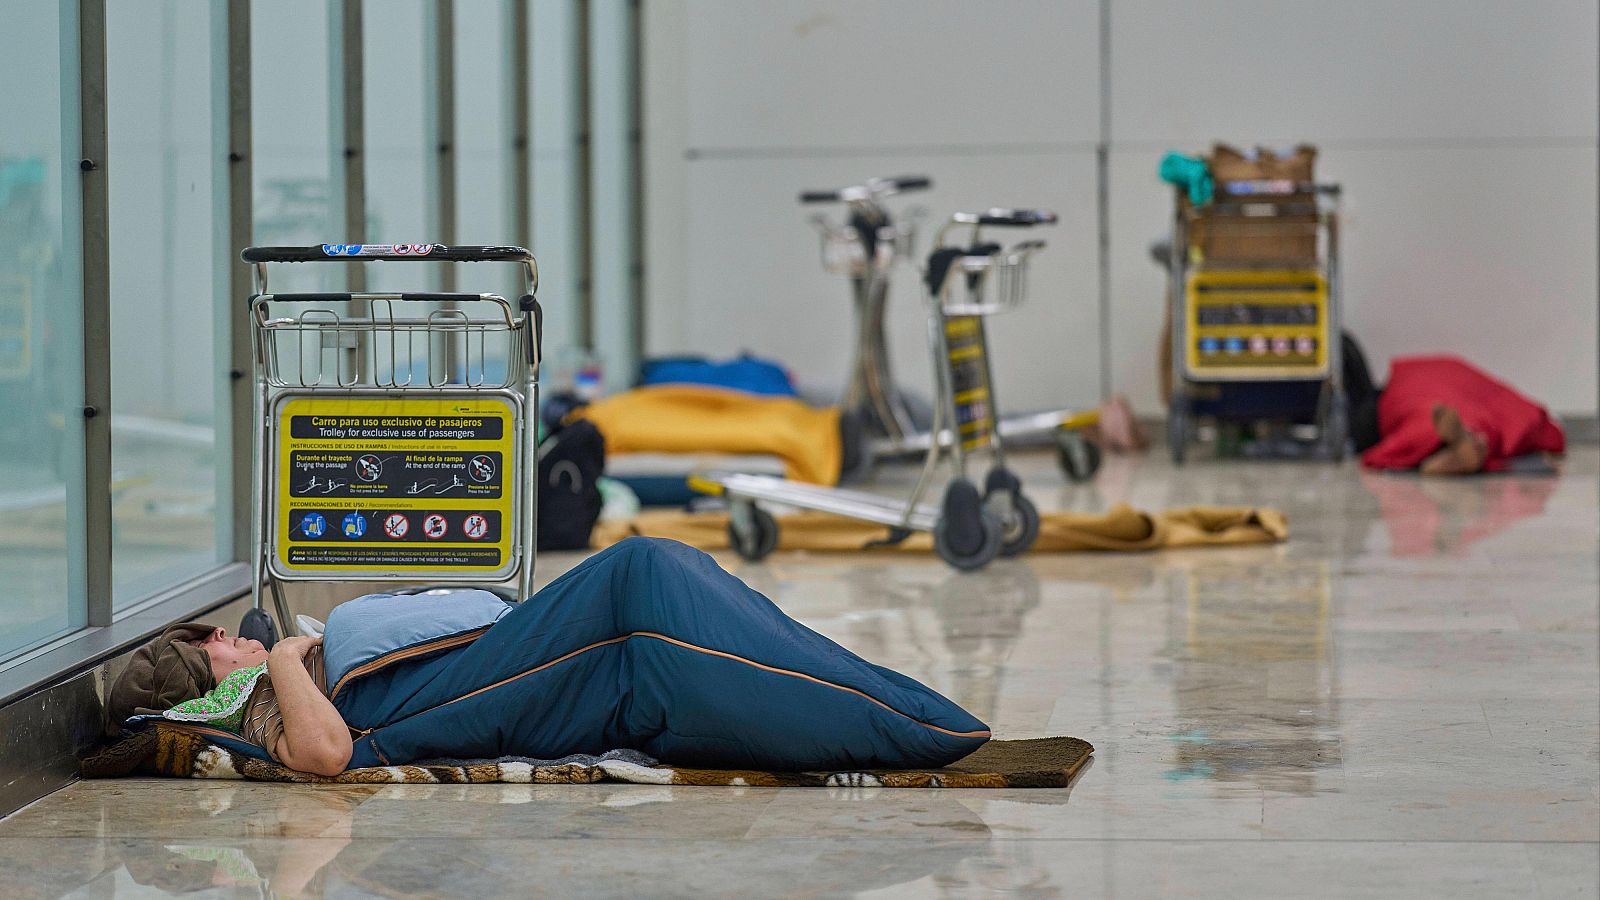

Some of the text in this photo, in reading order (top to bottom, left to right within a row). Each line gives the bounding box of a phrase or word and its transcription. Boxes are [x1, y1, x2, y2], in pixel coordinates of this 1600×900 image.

[312, 417, 337, 426] Carro
[340, 419, 360, 428] para
[382, 417, 422, 426] exclusivo
[425, 417, 436, 426] de
[440, 418, 482, 428] pasajeros
[319, 428, 346, 438] Trolley
[348, 428, 360, 436] for
[362, 428, 399, 437] exclusive
[418, 428, 426, 437] of
[429, 430, 474, 439] passengers
[328, 454, 352, 462] trayecto
